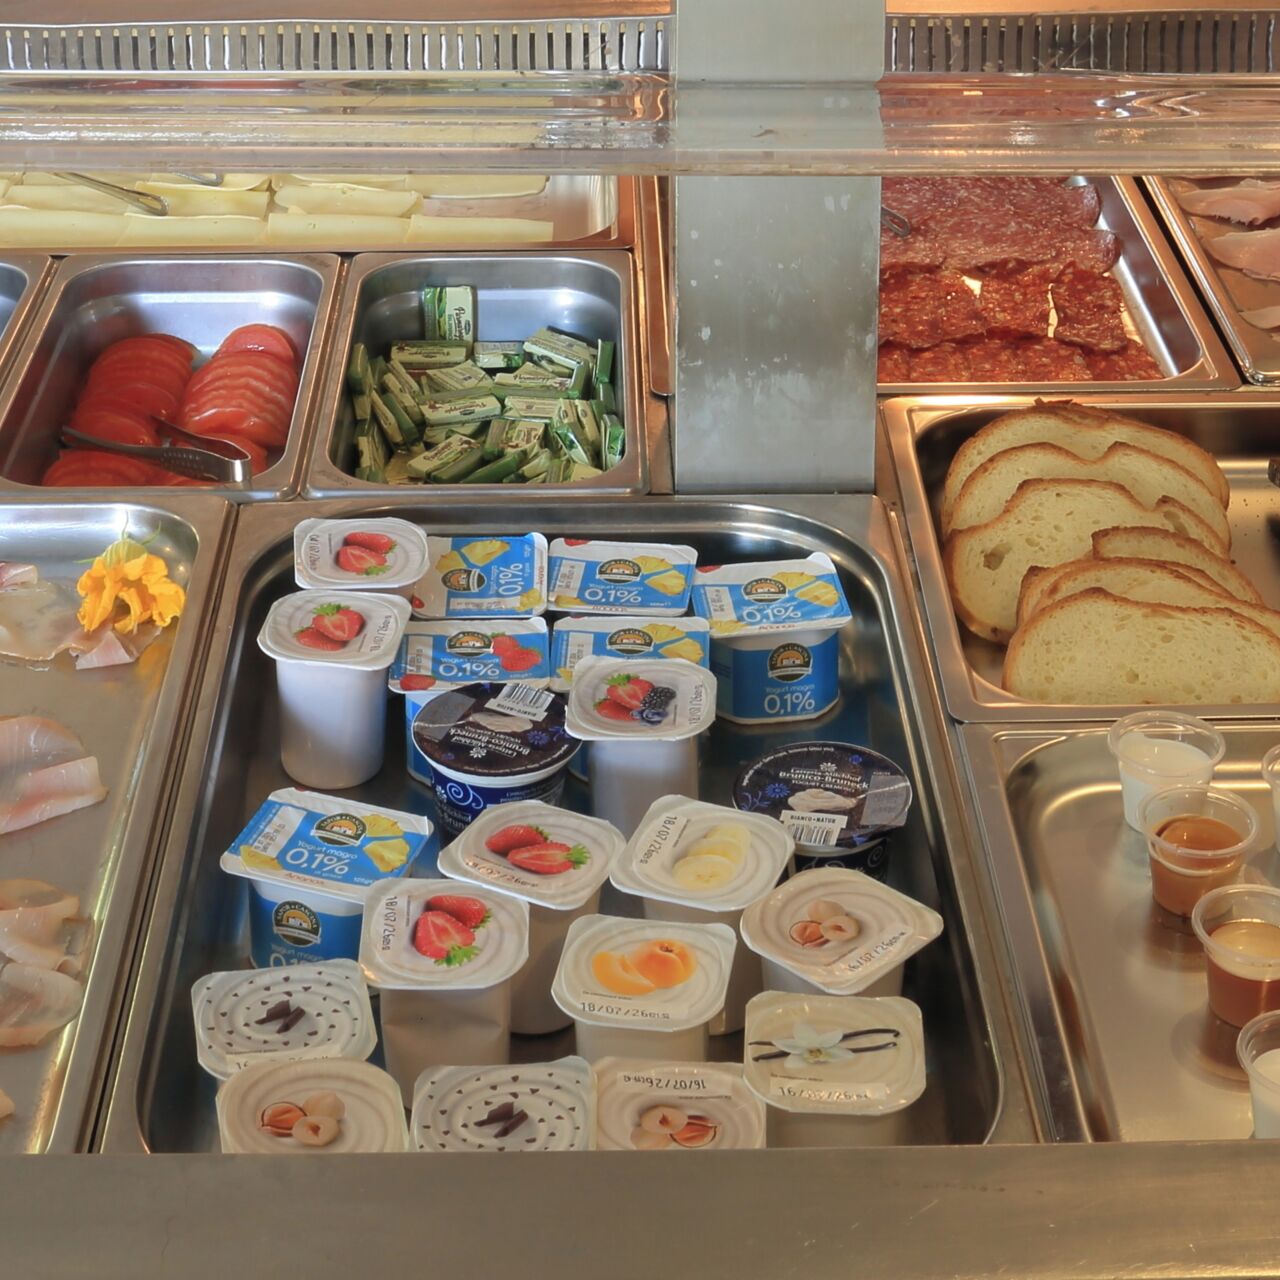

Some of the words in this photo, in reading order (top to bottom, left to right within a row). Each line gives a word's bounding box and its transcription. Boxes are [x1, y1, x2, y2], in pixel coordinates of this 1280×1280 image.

[498, 563, 524, 596] 0,1%
[584, 588, 642, 604] 0,1%
[742, 606, 801, 625] 0,1%
[438, 663, 500, 677] 0,1%
[764, 692, 816, 715] 0,1%
[297, 839, 327, 853] Yogurt
[326, 846, 359, 860] magro
[285, 847, 349, 876] 0,1%
